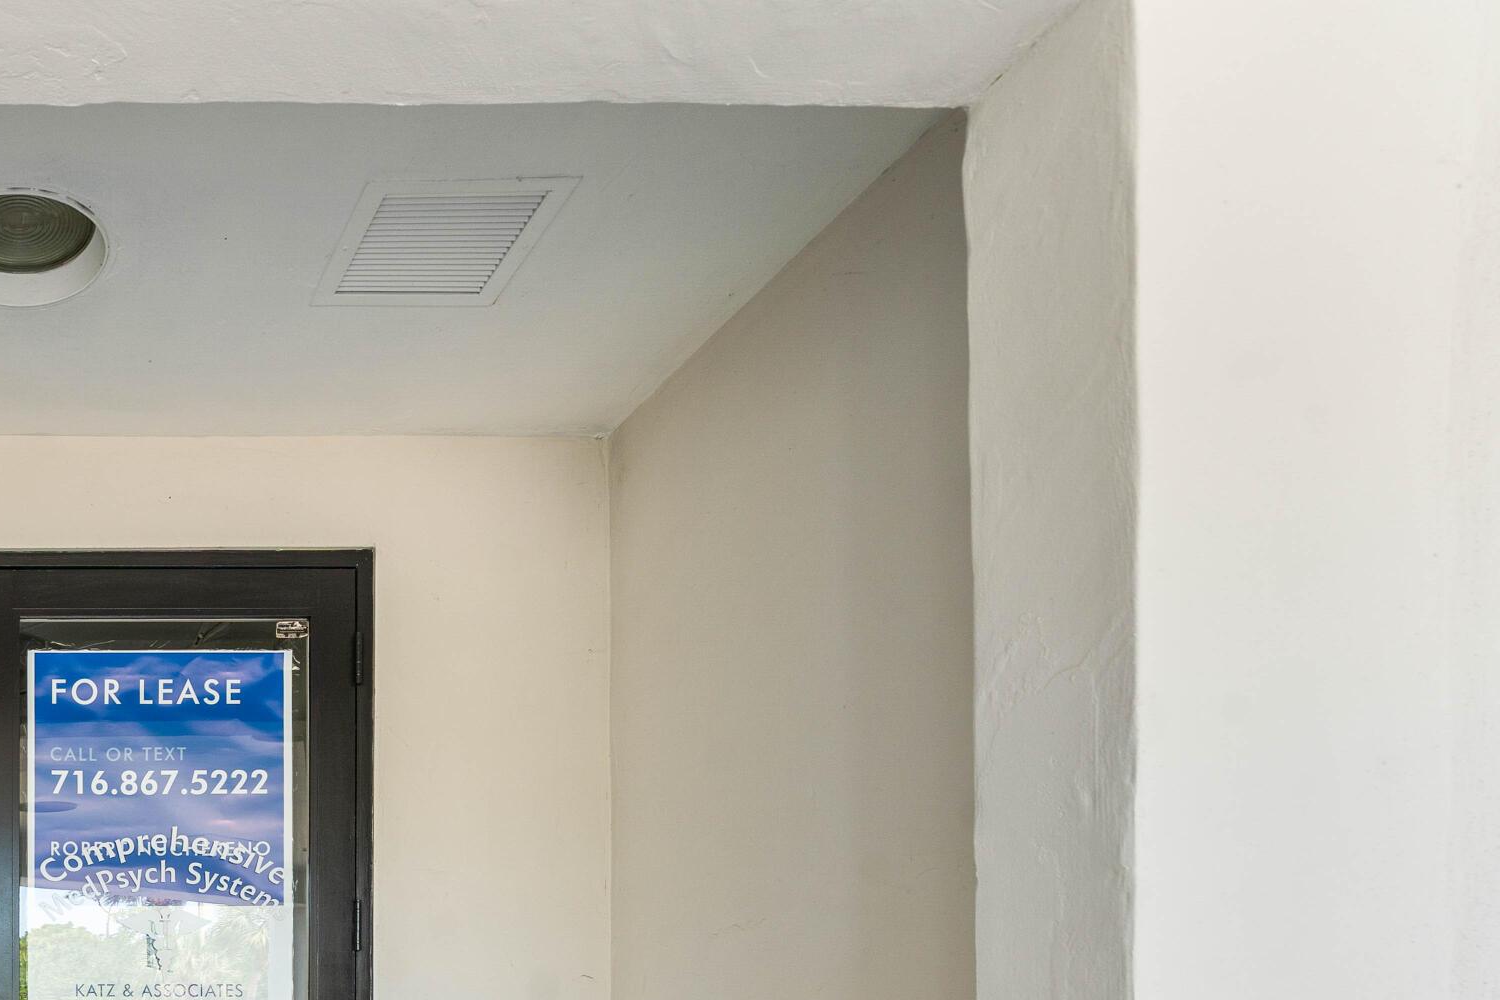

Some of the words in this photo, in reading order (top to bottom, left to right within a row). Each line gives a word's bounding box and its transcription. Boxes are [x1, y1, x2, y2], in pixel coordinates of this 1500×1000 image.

[51, 678, 122, 705] FOR
[139, 678, 242, 705] LEASE
[50, 747, 98, 762] CALL
[106, 747, 133, 762] OR
[142, 747, 187, 761] TEXT
[51, 769, 269, 796] 716.867.5222
[39, 826, 286, 885] Comprehensive
[38, 859, 176, 922] MedPsych
[75, 983, 116, 997] KATZ
[122, 983, 134, 998] &
[141, 983, 244, 998] ASSOCIATES
